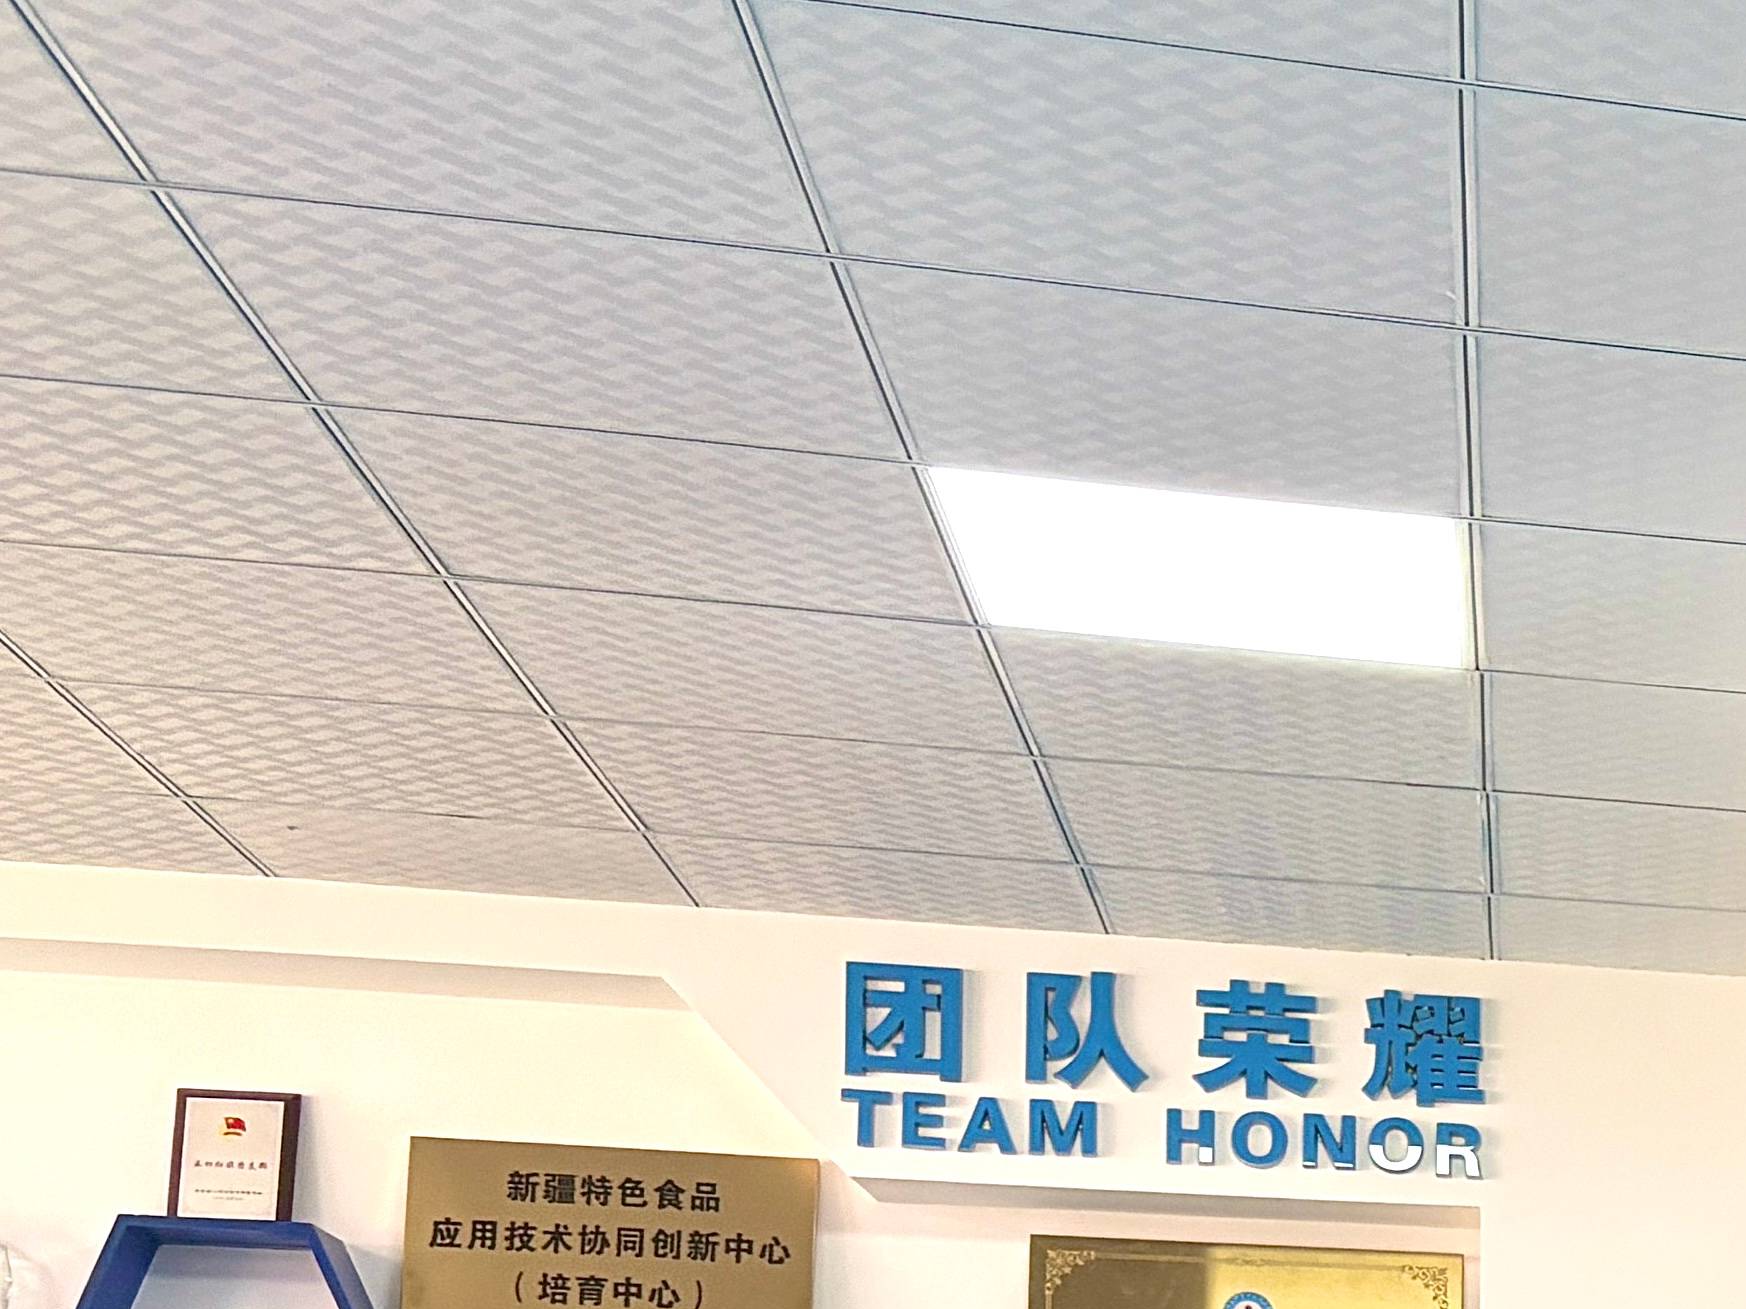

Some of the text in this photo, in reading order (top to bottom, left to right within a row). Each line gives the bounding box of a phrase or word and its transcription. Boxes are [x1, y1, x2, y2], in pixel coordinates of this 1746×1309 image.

[844, 960, 1487, 1107] 团队荣耀
[841, 1088, 1484, 1180] TEAM HONOR
[507, 1170, 721, 1213] 新疆特色食品
[429, 1219, 791, 1265] 应用技术协同创新中心
